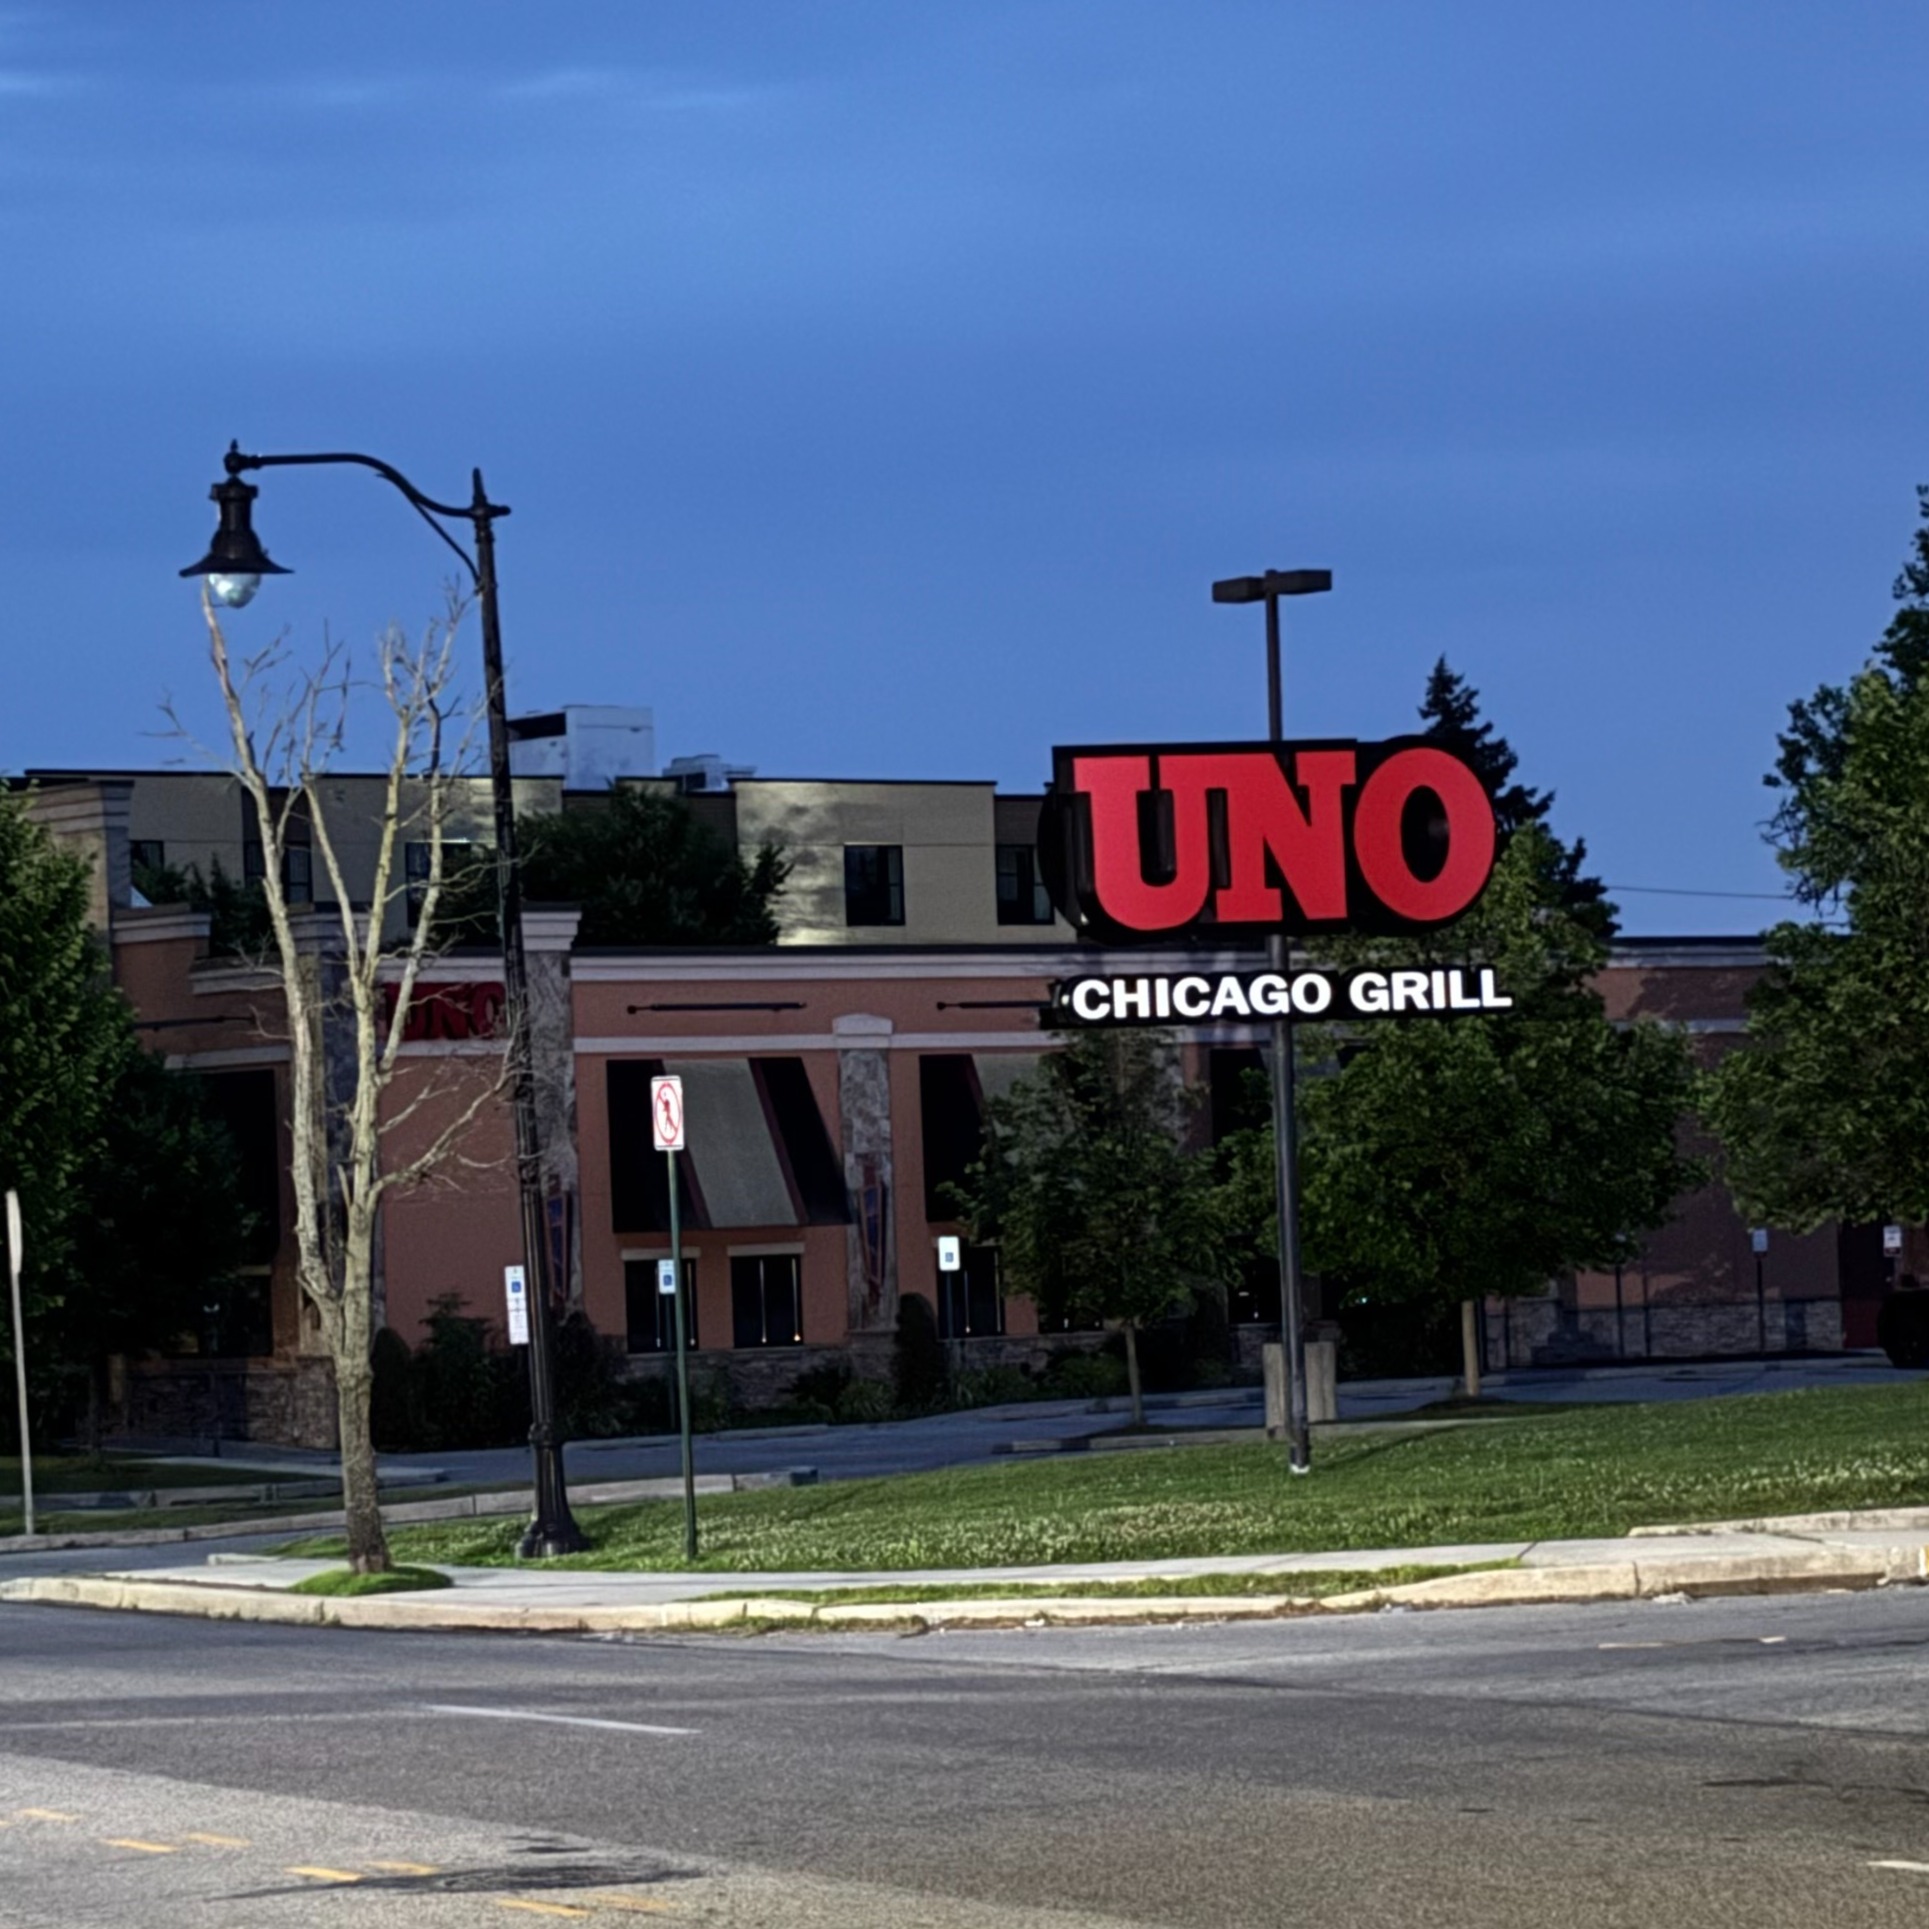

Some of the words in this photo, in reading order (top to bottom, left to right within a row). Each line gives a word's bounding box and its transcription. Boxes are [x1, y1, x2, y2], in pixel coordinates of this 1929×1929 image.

[1072, 747, 1496, 931] UNO
[1072, 973, 1332, 1020] CHICAGO
[1349, 969, 1513, 1012] GRILL
